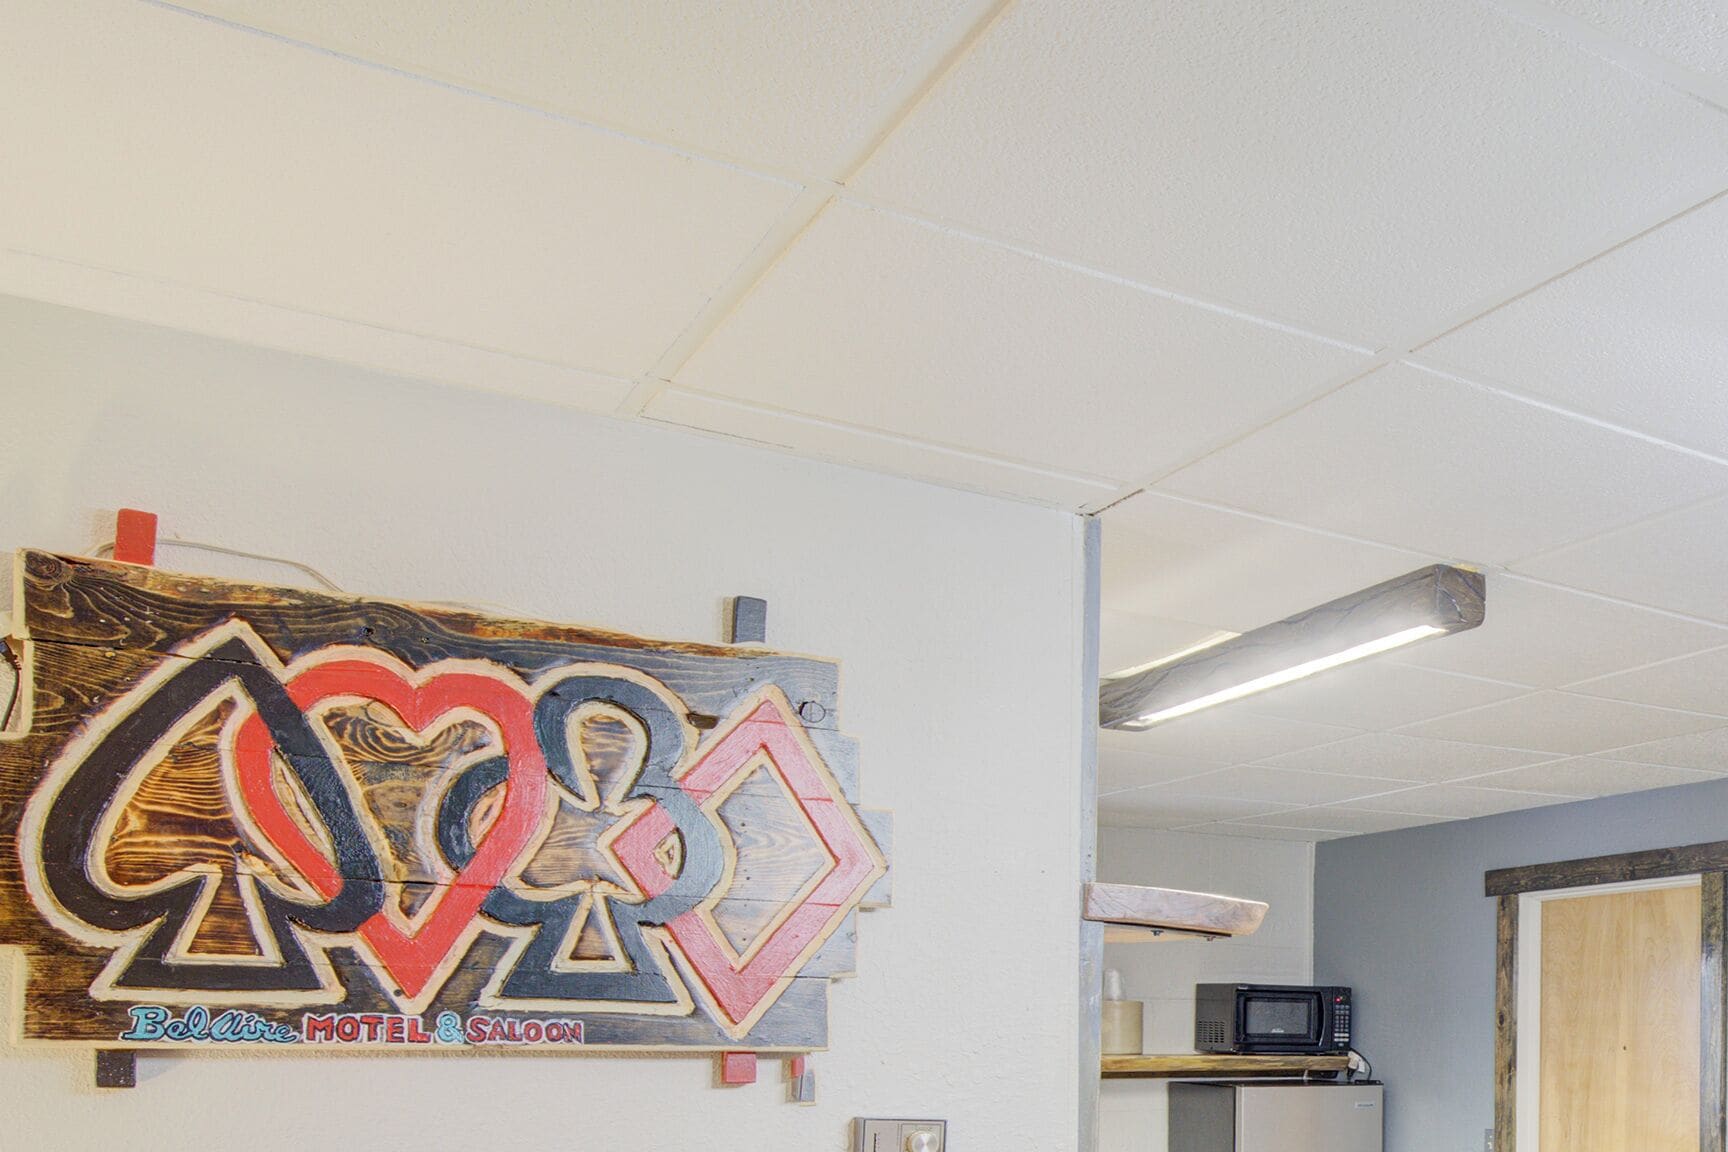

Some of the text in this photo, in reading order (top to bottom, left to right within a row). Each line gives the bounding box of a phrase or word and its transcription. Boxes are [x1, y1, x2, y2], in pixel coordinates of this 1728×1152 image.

[306, 1014, 431, 1043] MOTEL
[437, 1013, 464, 1044] &
[466, 1016, 582, 1043] SALOON
